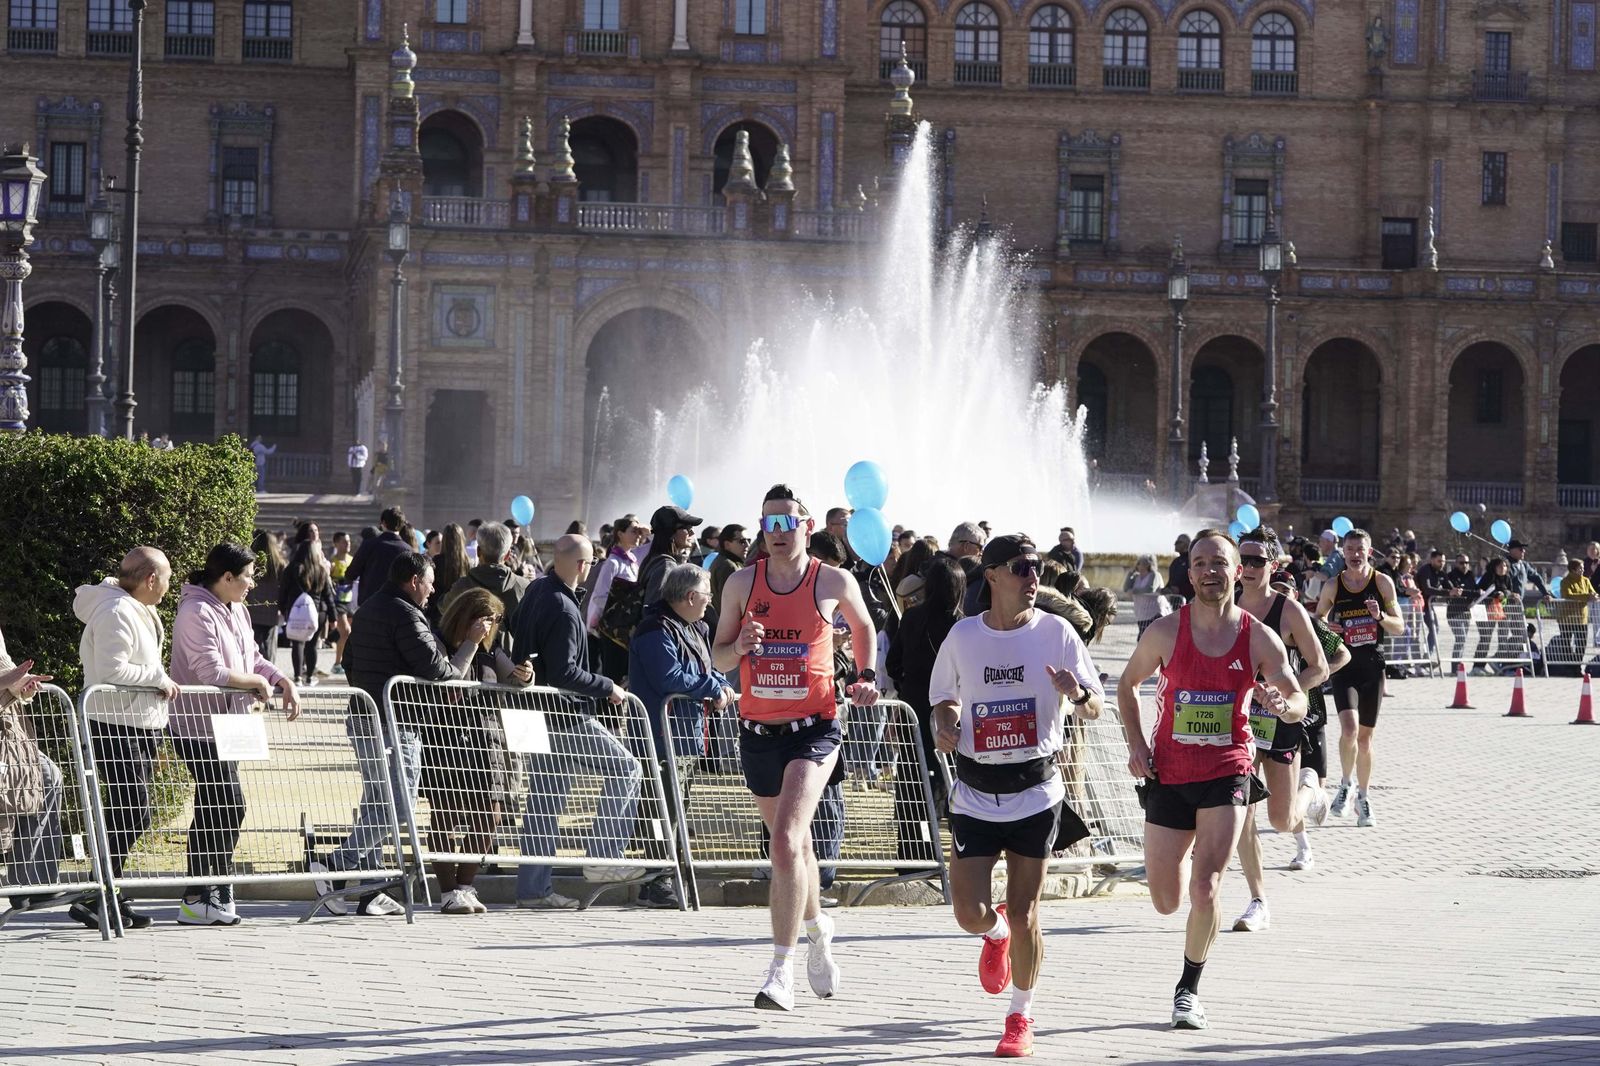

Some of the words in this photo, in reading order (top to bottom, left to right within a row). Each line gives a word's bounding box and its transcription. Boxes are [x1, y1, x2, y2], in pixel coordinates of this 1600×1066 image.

[764, 629, 802, 640] EXLEY
[767, 646, 801, 655] ZURICH
[770, 663, 785, 671] 678
[757, 673, 800, 685] WRIGHT
[984, 665, 1025, 684] GUANCHE
[1194, 694, 1228, 702] ZURICH
[991, 702, 1028, 714] ZURICH
[1195, 711, 1214, 719] 1726
[996, 722, 1012, 731] 762
[1186, 721, 1221, 733] TONIO
[986, 733, 1027, 749] GUADA
